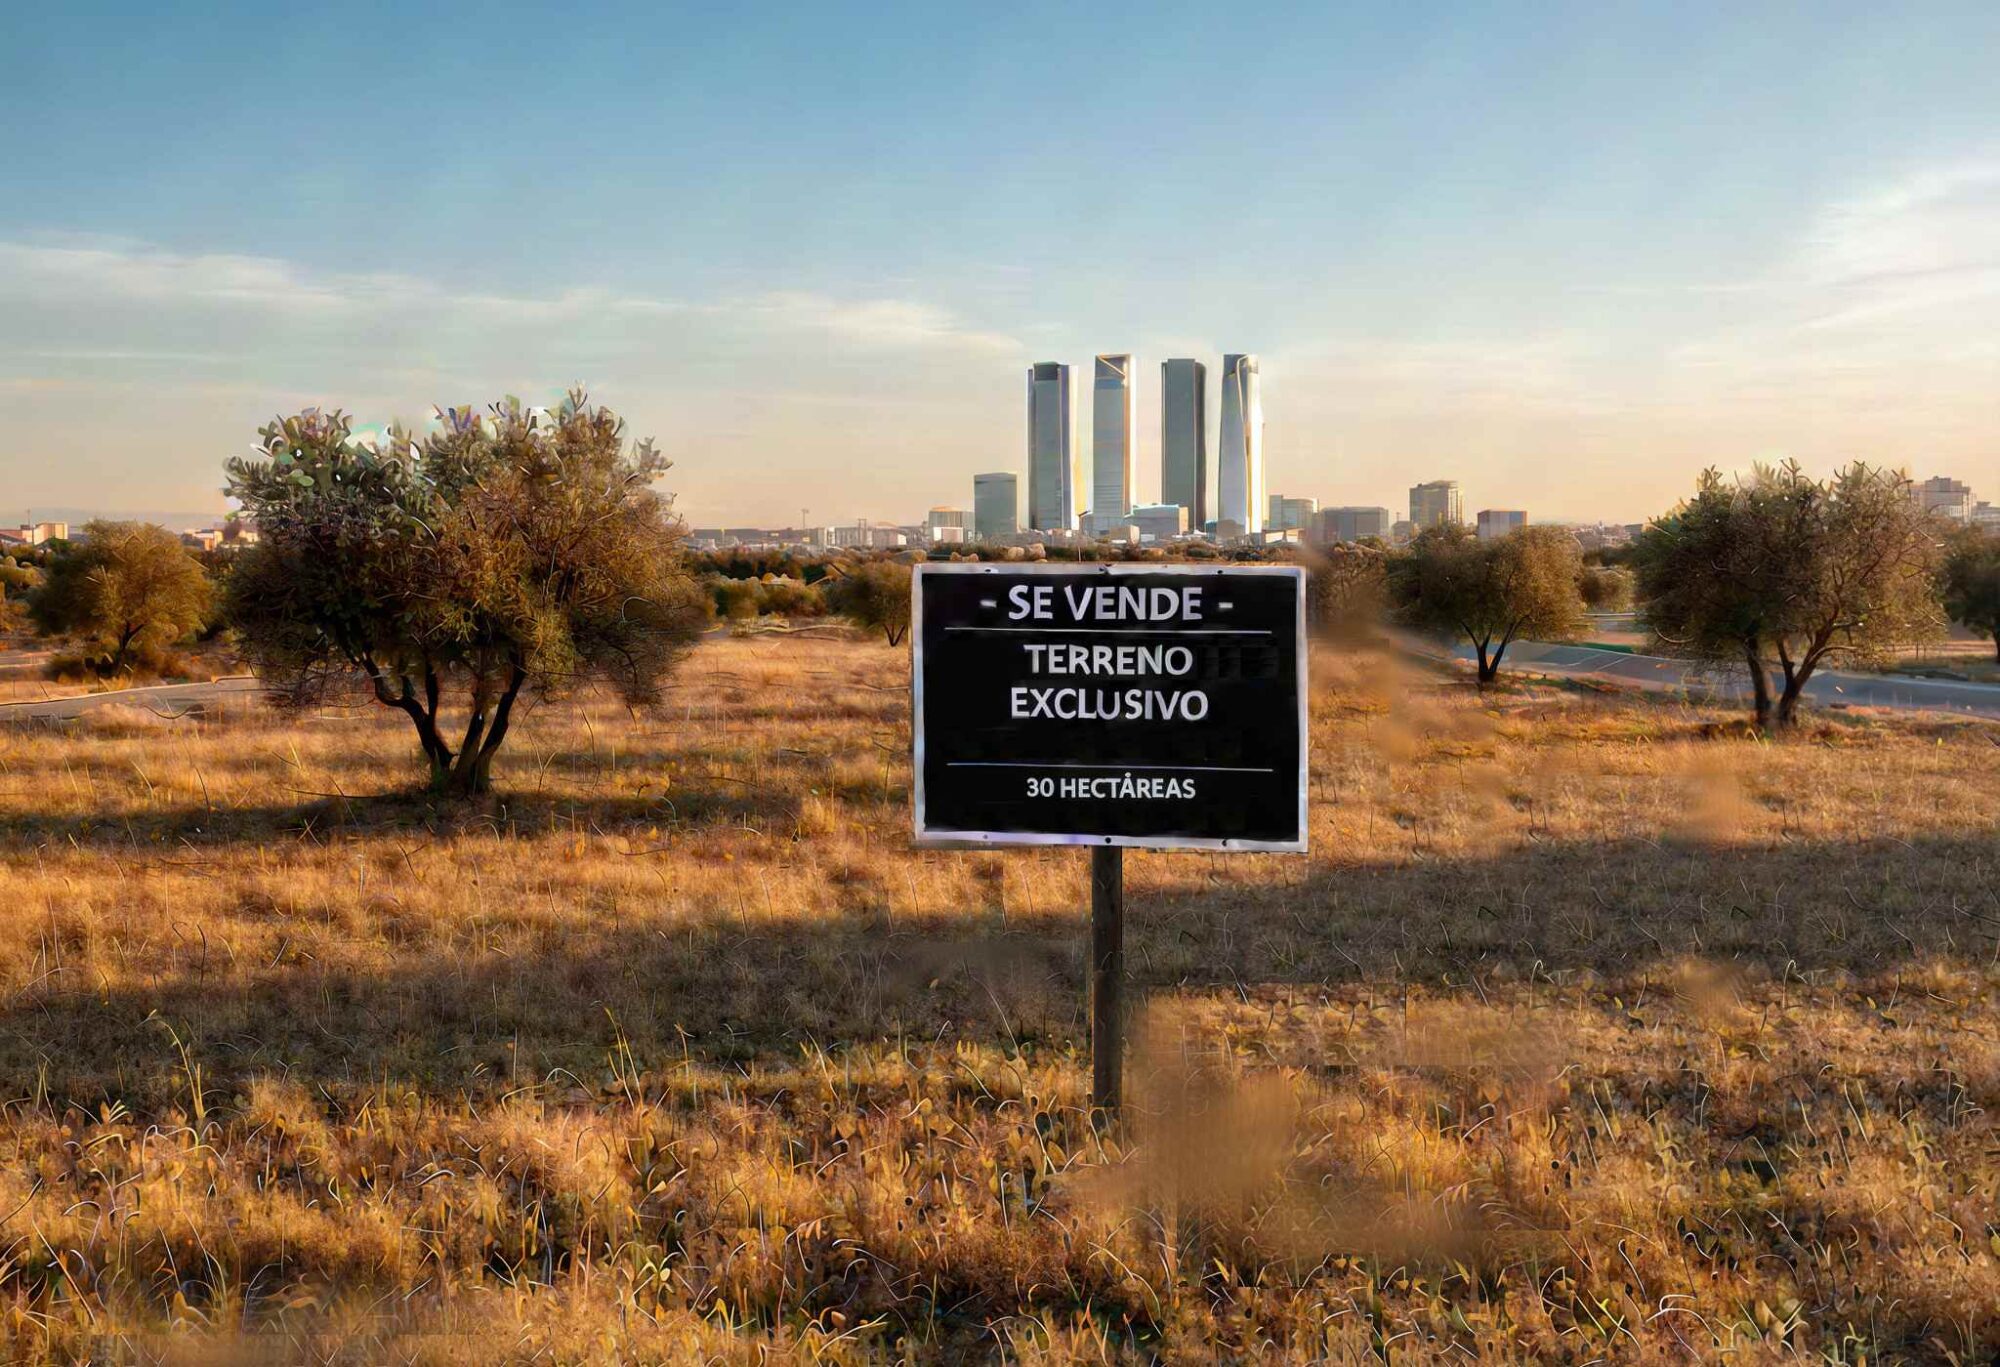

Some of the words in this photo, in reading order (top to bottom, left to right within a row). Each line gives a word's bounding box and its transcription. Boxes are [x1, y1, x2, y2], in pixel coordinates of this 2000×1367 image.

[1008, 585, 1054, 620] SE
[1064, 586, 1202, 621] VENDE
[1023, 644, 1193, 676] TERRENO
[1011, 687, 1209, 721] EXCLUSIVO
[1026, 777, 1055, 798] 30
